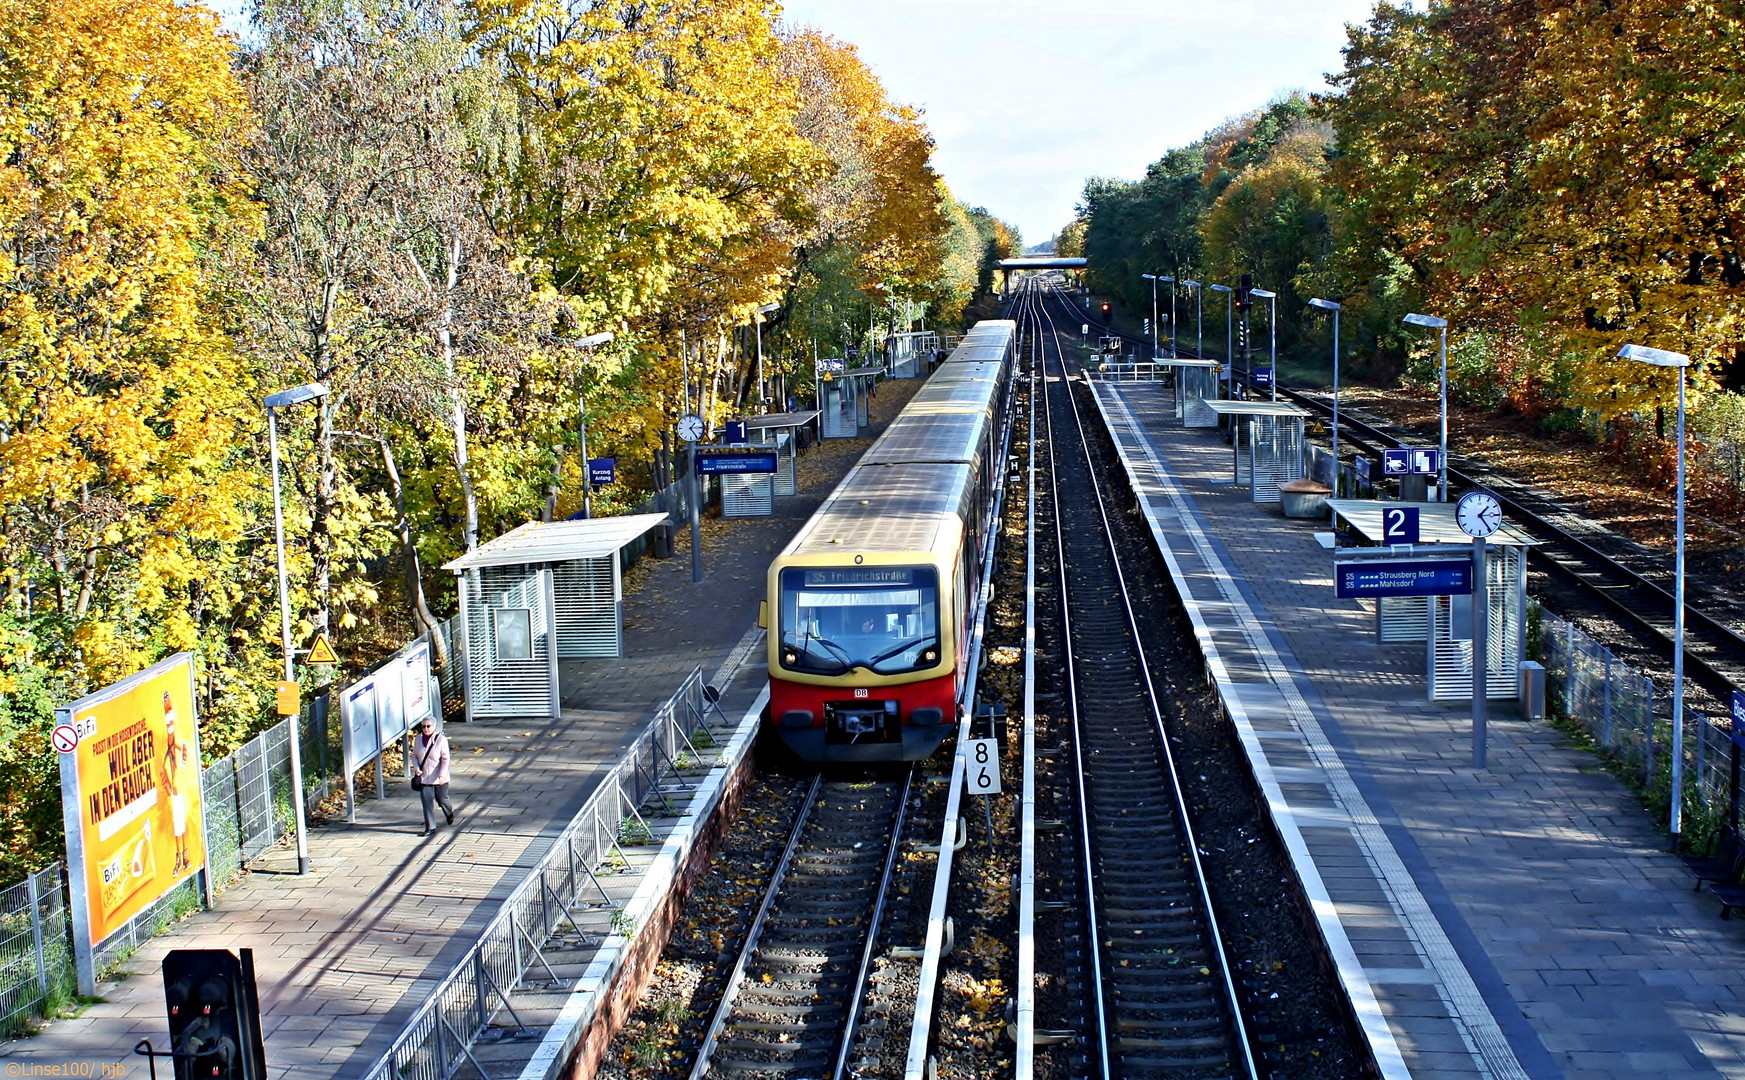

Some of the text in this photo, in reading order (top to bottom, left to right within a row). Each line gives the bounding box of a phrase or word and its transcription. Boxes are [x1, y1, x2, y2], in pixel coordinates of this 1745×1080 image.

[737, 421, 745, 438] 1
[1011, 461, 1019, 471] H
[1388, 509, 1406, 537] 2
[812, 571, 826, 582] S5
[1345, 570, 1435, 580] S5 Strausberg Nord
[1345, 579, 1414, 589] S5 Mahlsdorf
[76, 719, 95, 739] BiFi
[108, 730, 155, 781] WILL ABER
[975, 742, 988, 763] 8
[977, 766, 991, 788] 6
[89, 762, 156, 826] IN DEN BAUCH.
[103, 862, 120, 883] BiFi
